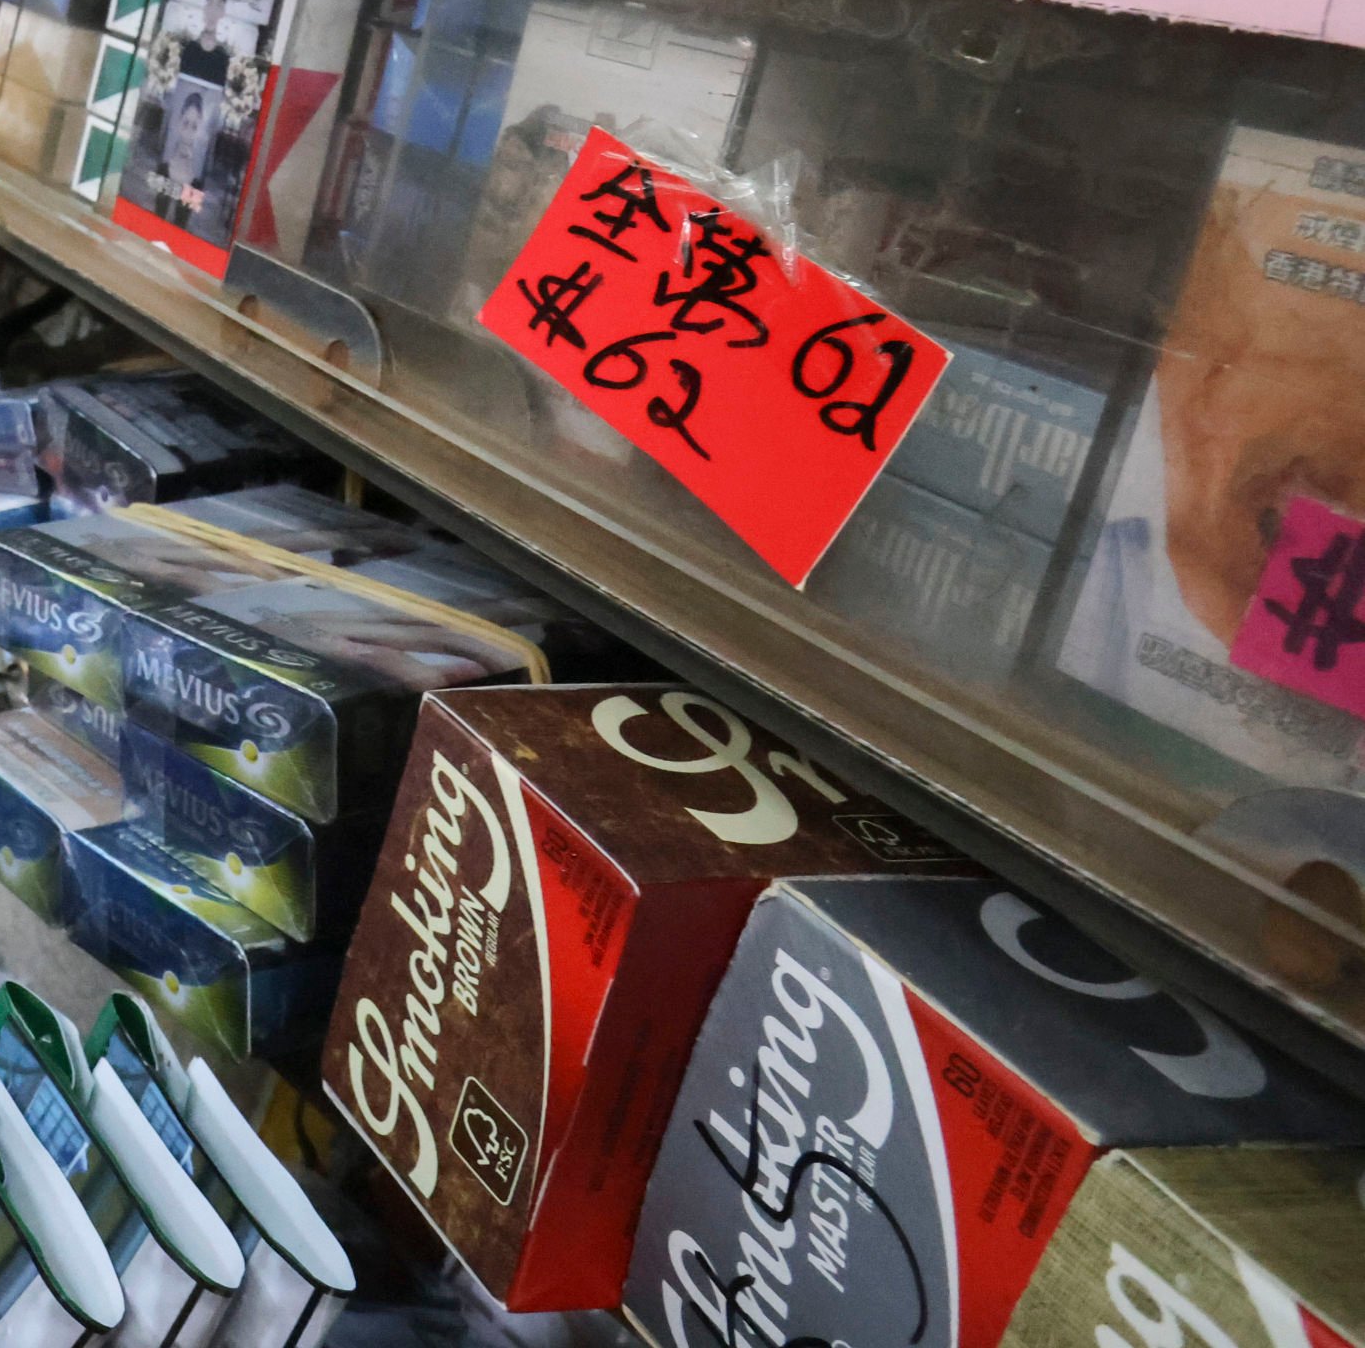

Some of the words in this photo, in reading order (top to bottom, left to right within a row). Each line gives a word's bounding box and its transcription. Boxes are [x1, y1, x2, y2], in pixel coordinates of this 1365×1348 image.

[790, 312, 909, 451] 62
[166, 604, 261, 652] MEVIUS
[136, 649, 240, 726] MEVIUS
[452, 885, 486, 1017] BROWN
[484, 911, 501, 967] REGULAR
[349, 750, 511, 1199] Smoking
[939, 1050, 985, 1100] 60
[495, 1136, 517, 1184] FSC
[856, 1144, 878, 1213] REULAR
